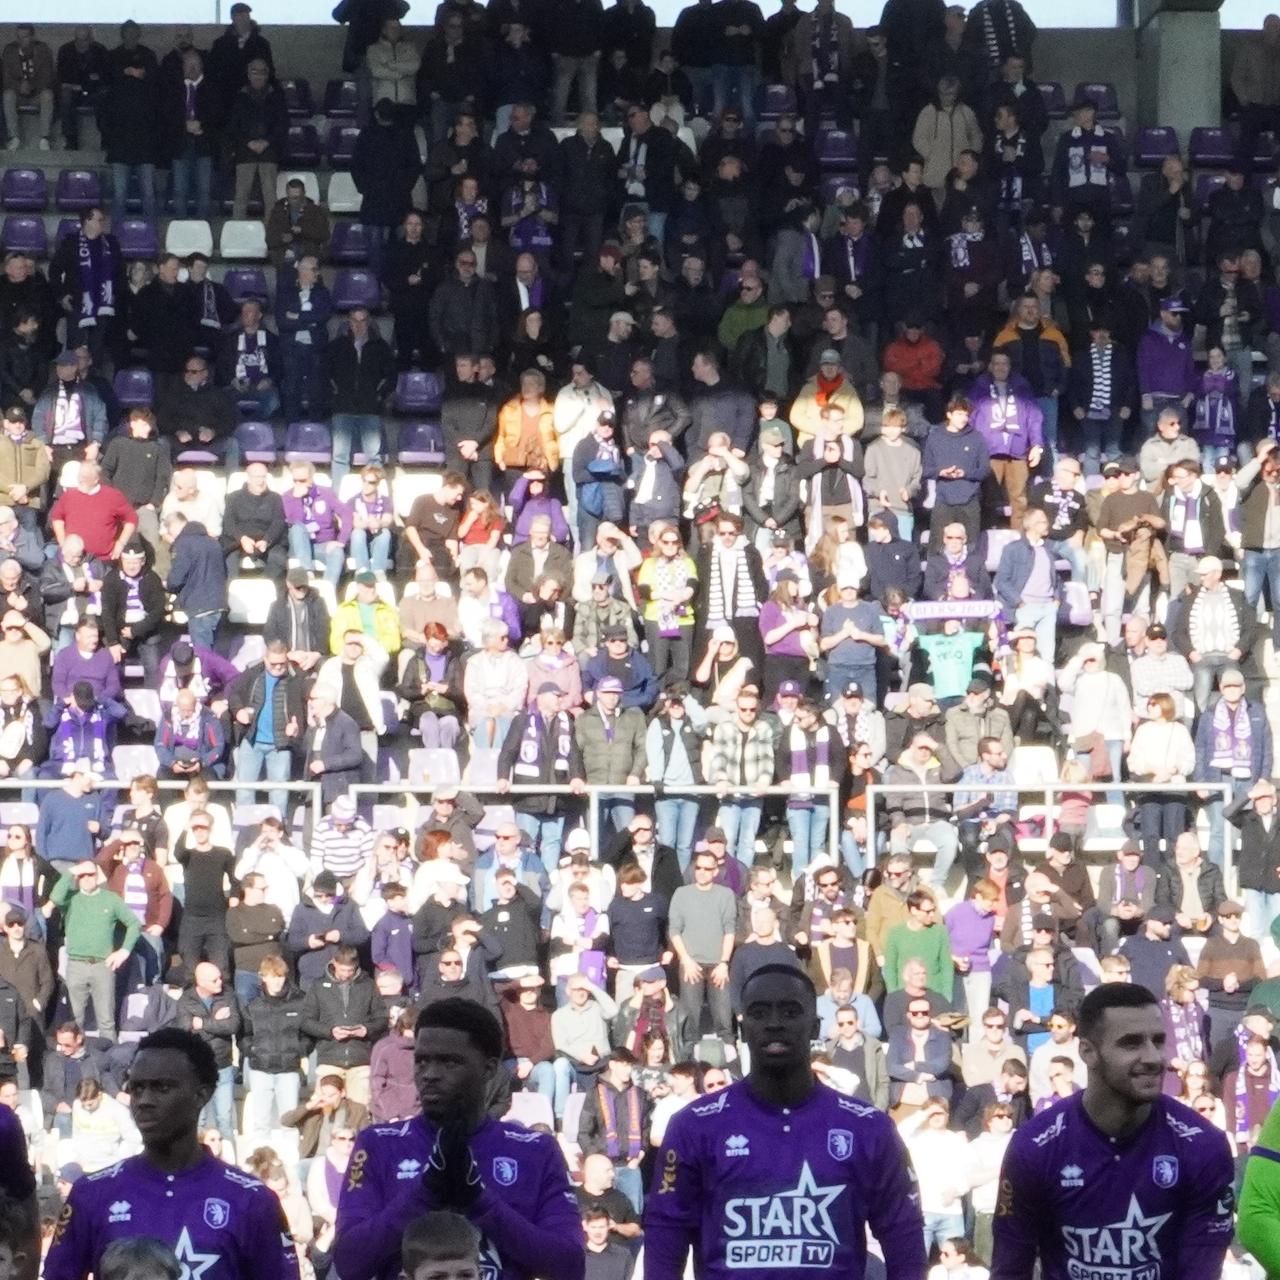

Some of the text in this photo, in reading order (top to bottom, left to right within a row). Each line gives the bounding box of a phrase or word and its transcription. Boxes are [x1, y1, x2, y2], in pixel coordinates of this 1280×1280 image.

[723, 1197, 822, 1237] STAR
[730, 1244, 829, 1263] SPORT TV
[1062, 1225, 1149, 1266] STAR
